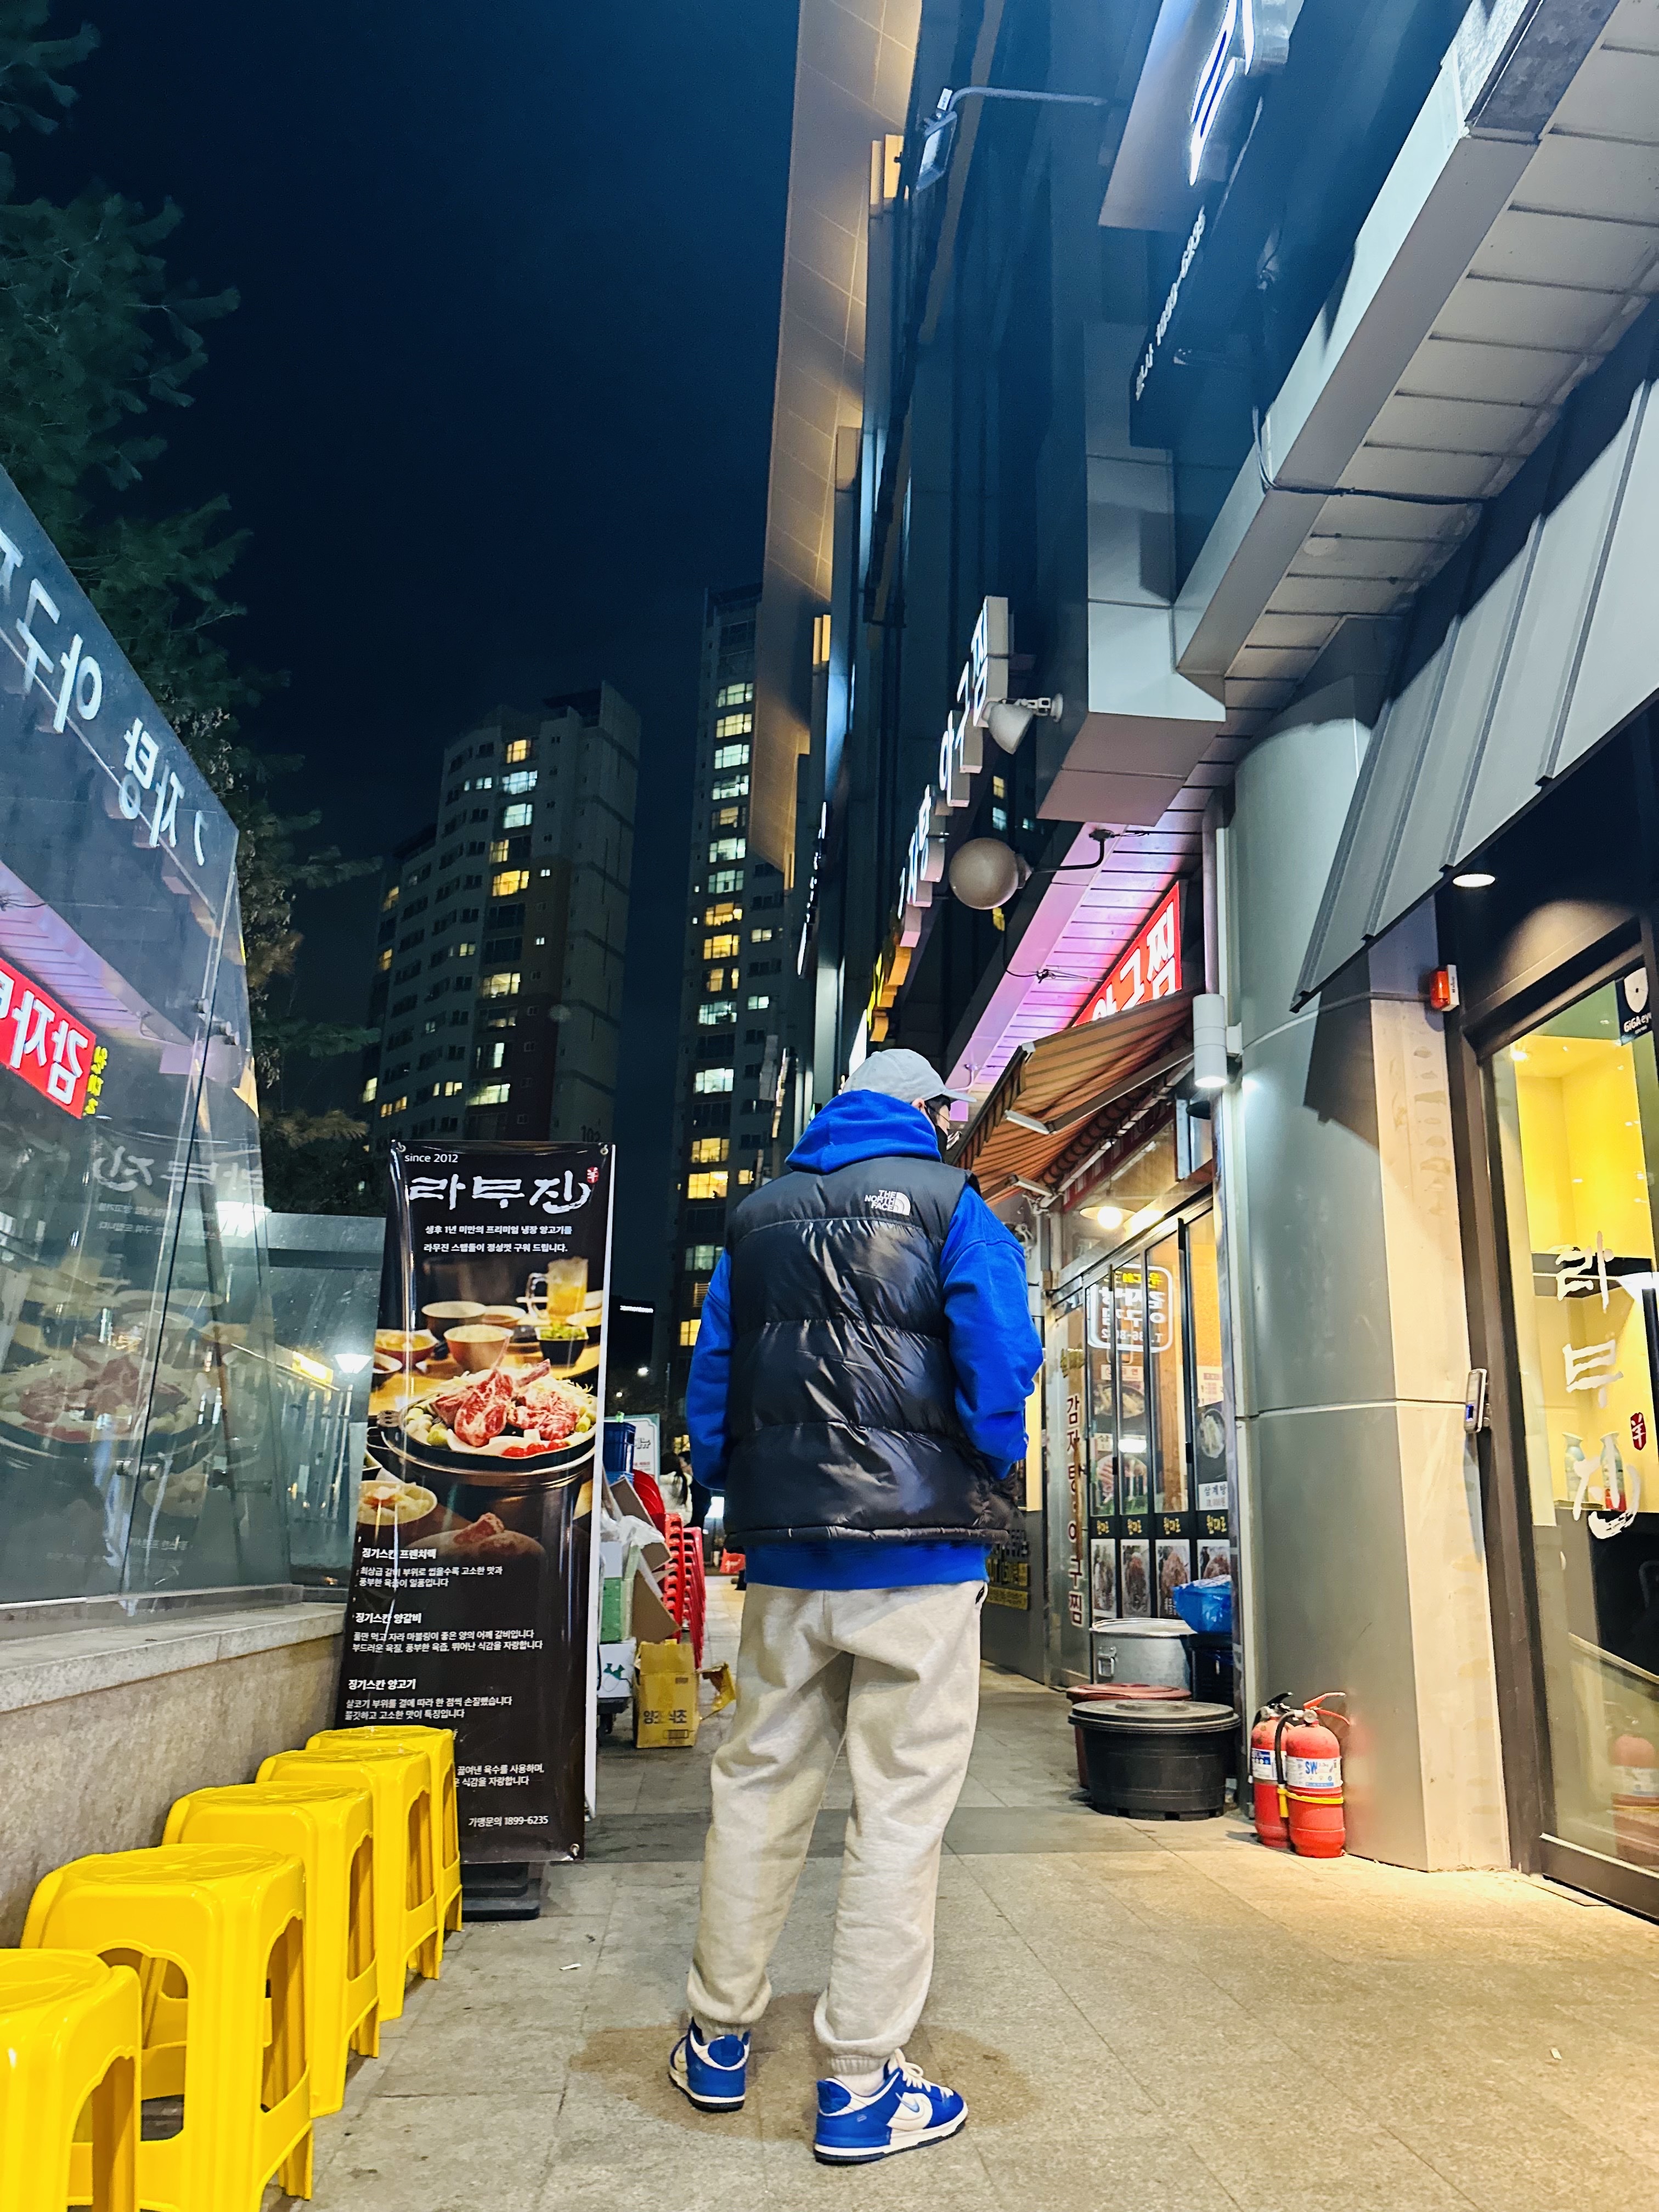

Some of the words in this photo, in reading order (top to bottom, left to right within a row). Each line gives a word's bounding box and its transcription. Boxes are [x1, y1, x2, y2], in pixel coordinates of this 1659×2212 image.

[404, 1153, 431, 1163] since
[433, 1154, 459, 1163] 2012
[409, 1170, 591, 1214] 라무진
[878, 1189, 896, 1198] THE
[864, 1194, 895, 1205] NORTH
[871, 1201, 894, 1211] FACE
[445, 1225, 457, 1234] 1년
[459, 1226, 484, 1234] 미만의
[486, 1226, 519, 1234] 프리미엄
[521, 1226, 538, 1234] 냉장
[539, 1225, 572, 1234] 양고기를
[424, 1243, 449, 1252] 라무진
[487, 1243, 512, 1252] 정성껏
[514, 1243, 531, 1252] 구워
[532, 1243, 568, 1252] 드립니다.
[1555, 1231, 1641, 1540] 라무진
[1204, 1483, 1227, 1496] 삼계탕
[362, 1548, 397, 1559] 징기스칸
[399, 1549, 437, 1559] 프렌치랙
[360, 1566, 383, 1576] 최상급
[402, 1567, 426, 1576] 부위로
[428, 1567, 459, 1576] 씹을수록
[461, 1567, 486, 1576] 고소한
[487, 1566, 503, 1575] 맛과
[359, 1577, 382, 1587] 풍부한
[409, 1578, 449, 1588] 일품입니다
[356, 1612, 392, 1624] 징기스칸
[393, 1612, 422, 1624] 양갈비
[353, 1632, 369, 1641] 풀만
[370, 1632, 387, 1641] 먹고
[388, 1633, 405, 1641] 자라
[406, 1632, 439, 1641] 마블링이
[441, 1631, 457, 1641] 좋은
[459, 1631, 475, 1640] 양의
[476, 1630, 493, 1640] 어깨
[494, 1629, 534, 1639] 갈비입니다
[352, 1643, 383, 1652] 부드러운
[405, 1643, 430, 1652] 풍부한
[452, 1641, 476, 1651] 뛰어난
[477, 1641, 501, 1651] 식감을
[503, 1640, 543, 1650] 자랑합니다
[348, 1679, 386, 1690] 징기스칸
[387, 1678, 416, 1690] 양고기
[346, 1699, 370, 1709] 살코기
[372, 1699, 397, 1708] 부위를
[399, 1699, 415, 1708] 결에
[416, 1698, 433, 1707] 따라
[435, 1698, 444, 1707] 한
[446, 1697, 462, 1707] 점씩
[464, 1696, 513, 1707] 손질했습니다
[345, 1711, 377, 1720] 쫄깃하고
[379, 1710, 404, 1720] 고소한
[405, 1709, 422, 1719] 맛이
[424, 1709, 465, 1719] 특징입니다
[458, 1765, 482, 1775] 끓여낸
[483, 1764, 508, 1775] 육수를
[462, 1777, 487, 1787] 식감을
[488, 1775, 529, 1786] 자랑합니다
[468, 1816, 502, 1827] 가맹문의
[504, 1815, 549, 1825] 1899-6235
